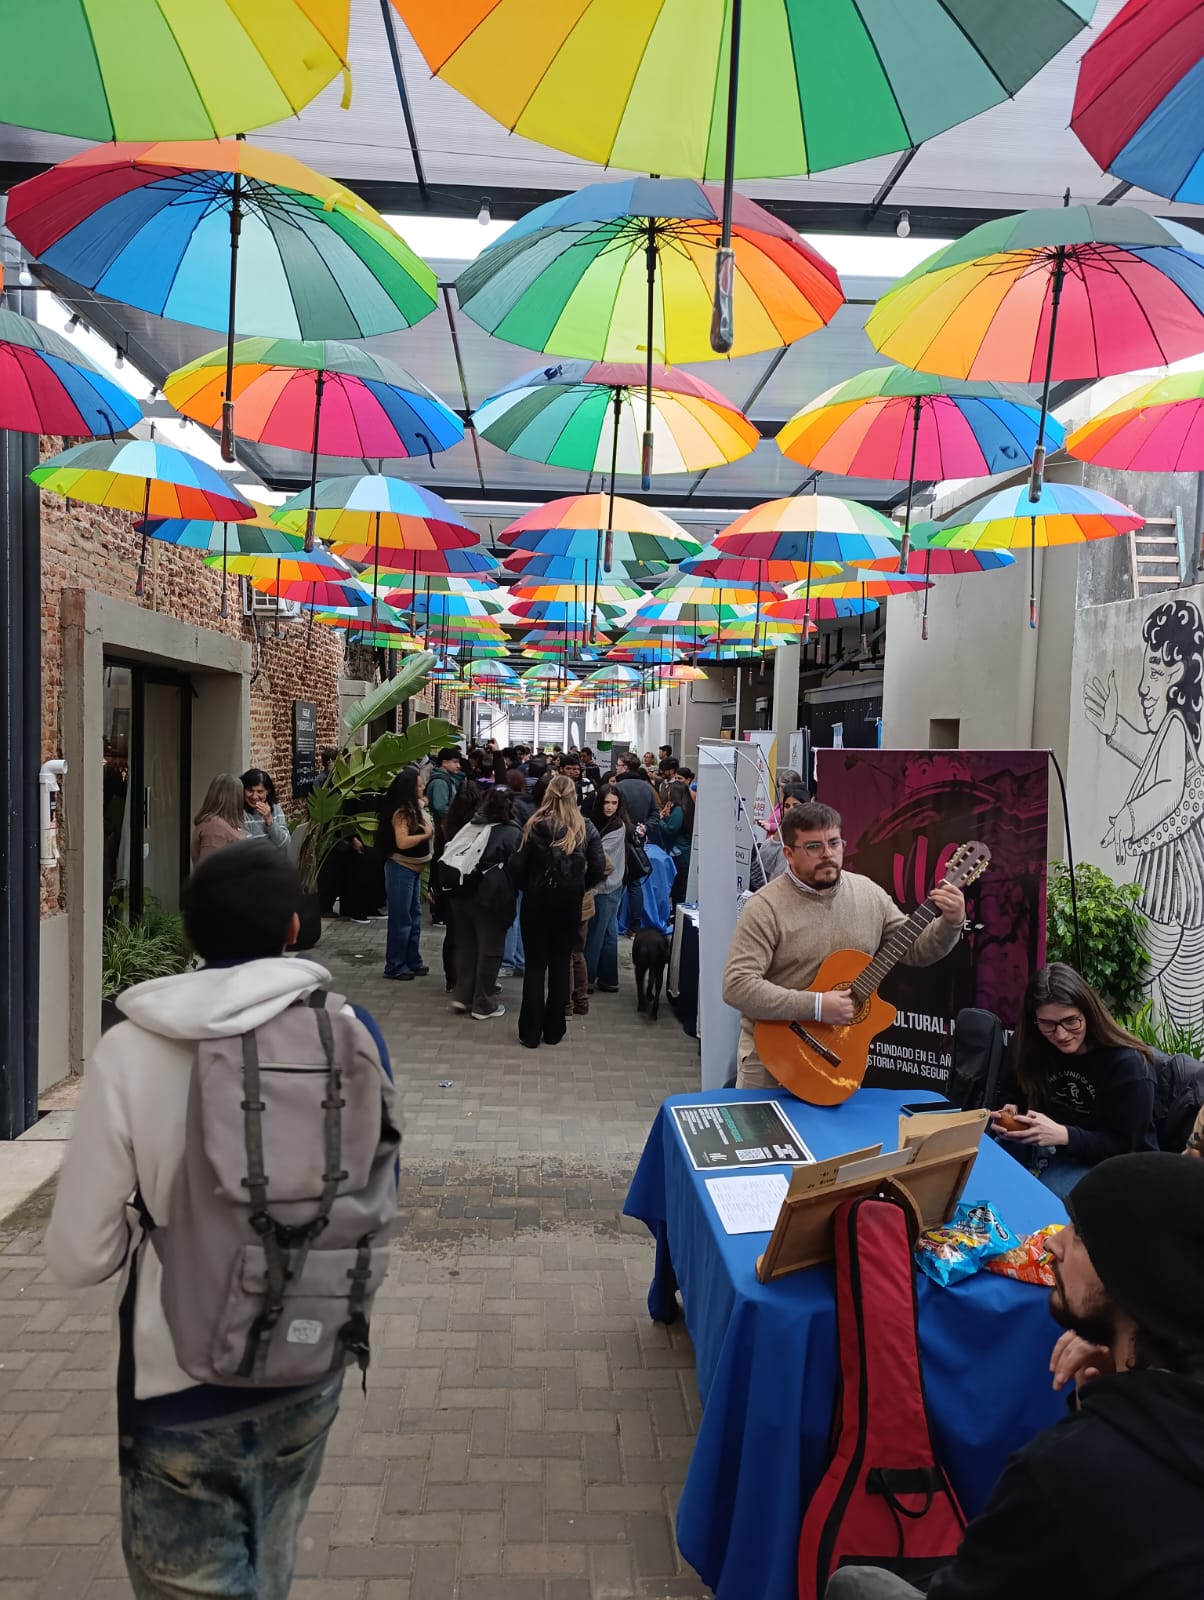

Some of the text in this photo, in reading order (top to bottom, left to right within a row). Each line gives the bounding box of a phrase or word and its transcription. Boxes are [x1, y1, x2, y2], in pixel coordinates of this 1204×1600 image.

[893, 1010, 947, 1035] ULTURAL
[867, 1054, 949, 1081] STORIA PARA SEGUIR
[876, 1042, 952, 1068] FUNDADO EN EL AÑ
